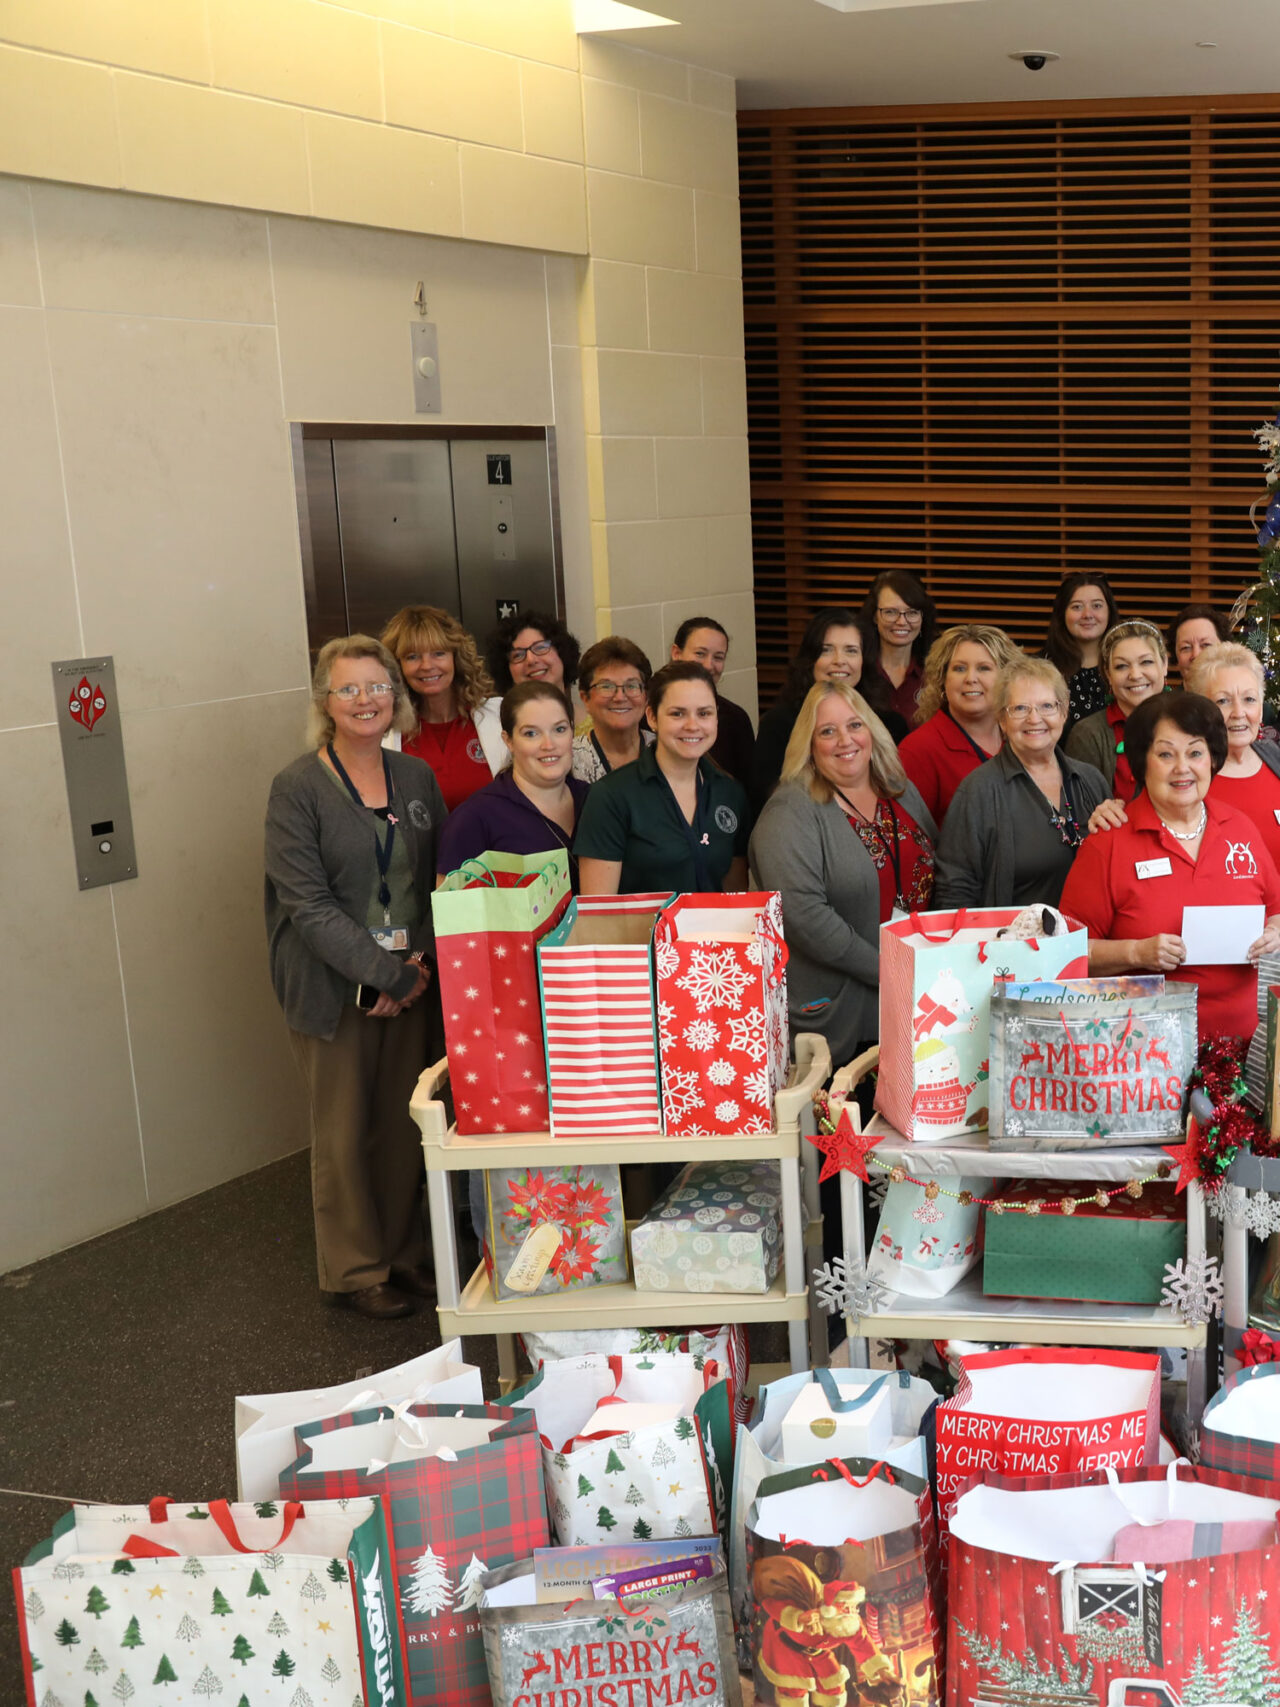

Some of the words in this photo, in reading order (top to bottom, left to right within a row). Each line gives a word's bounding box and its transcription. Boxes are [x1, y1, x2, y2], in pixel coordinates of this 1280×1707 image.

[414, 280, 428, 316] 4
[495, 460, 504, 484] 4
[1046, 1042, 1143, 1077] MERRY
[1009, 1075, 1182, 1114] CHRISTMAS
[941, 1415, 1003, 1440] MERRY
[1006, 1421, 1112, 1448] CHRISTMAS
[542, 1552, 716, 1580] LIGHTHO
[624, 1578, 659, 1593] LARGE
[661, 1570, 693, 1584] PRINT
[448, 1627, 458, 1637] &
[551, 1634, 673, 1684] MERRY
